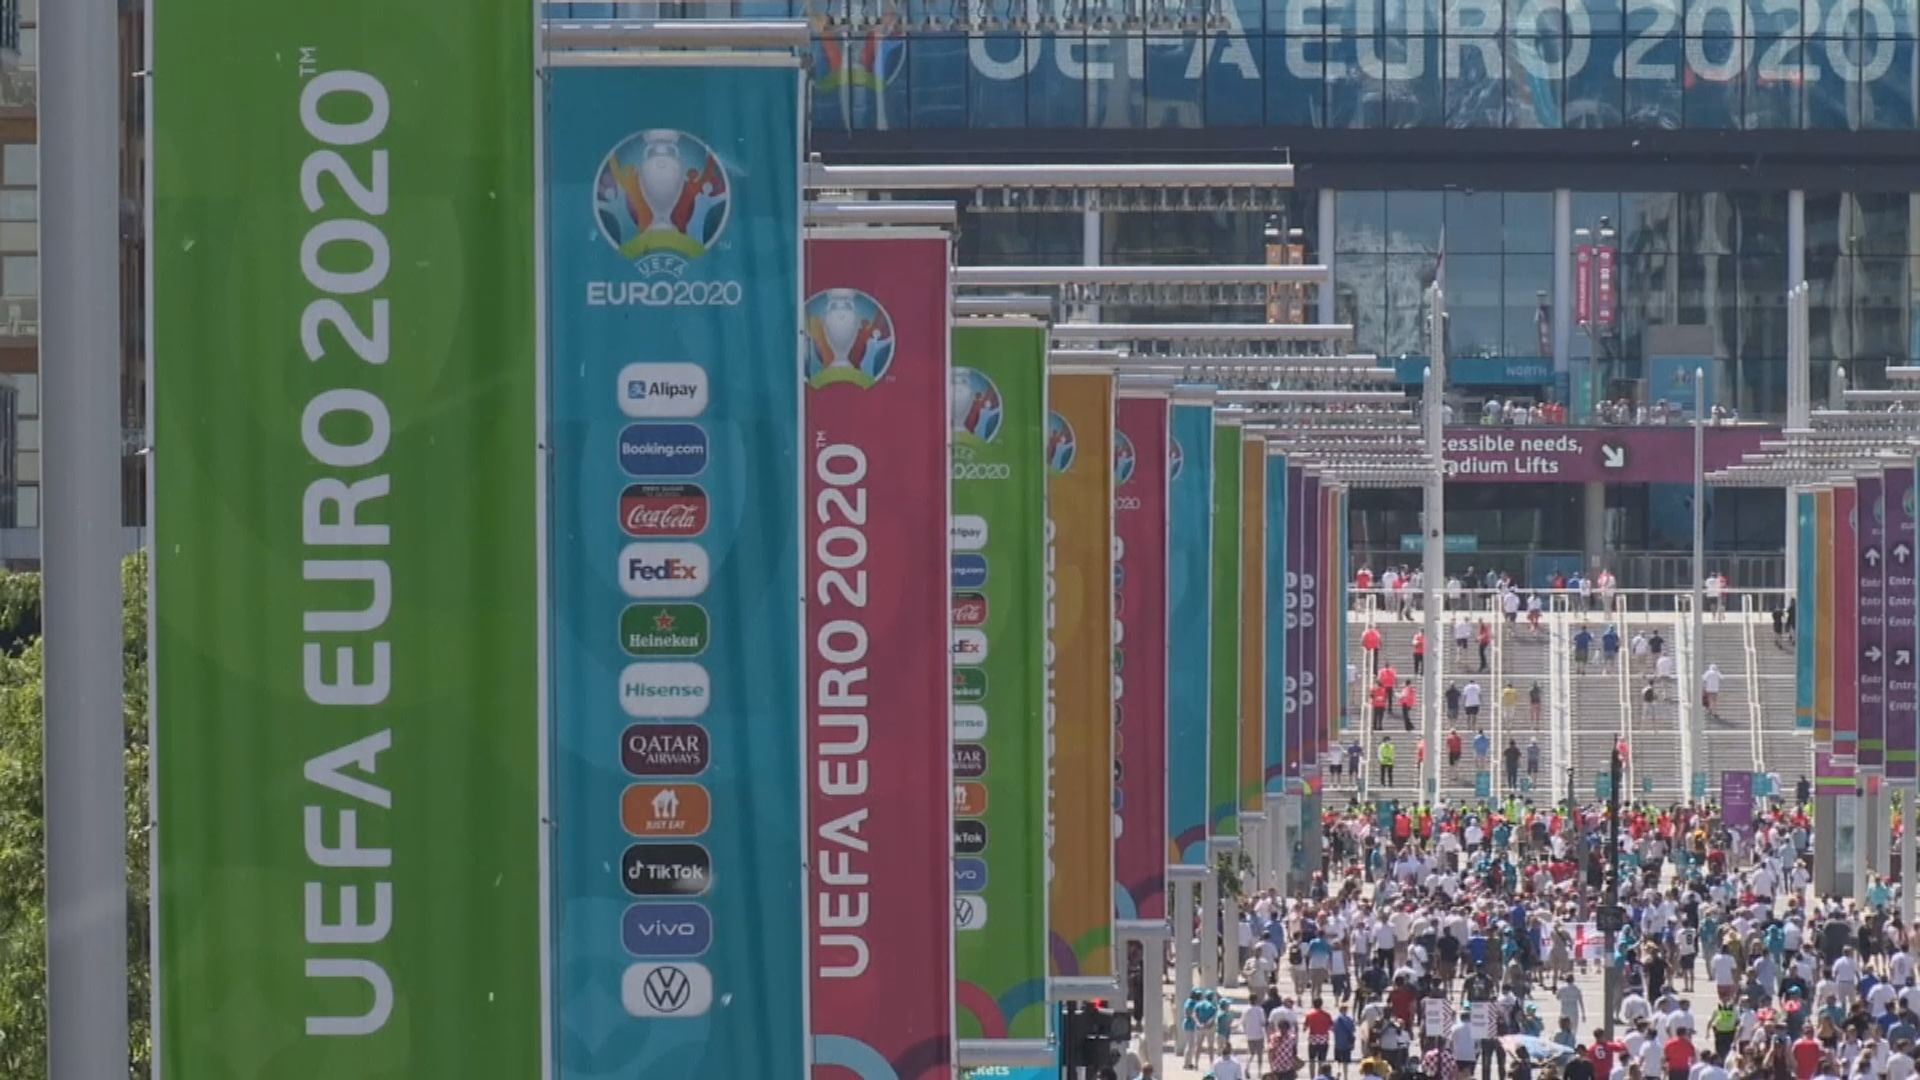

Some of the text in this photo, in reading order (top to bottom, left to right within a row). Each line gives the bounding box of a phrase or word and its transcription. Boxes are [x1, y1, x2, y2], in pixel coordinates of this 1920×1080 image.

[967, 0, 1897, 82] UEFA EURO 2020
[299, 69, 391, 364] 2020
[1506, 366, 1548, 377] NORTH
[649, 381, 697, 400] Alipay
[622, 442, 704, 458] Booking.com
[1521, 435, 1583, 455] needs,
[1514, 456, 1560, 474] Lifts
[816, 443, 868, 608] 2020
[301, 387, 392, 706] EURO
[629, 558, 697, 581] FedEx
[629, 633, 699, 647] Heineken
[625, 683, 704, 698] Hisense
[816, 619, 869, 796] EURO
[629, 735, 700, 755] QATAR
[646, 753, 701, 765] AIRWAYS
[646, 820, 686, 830] JUST EAT
[648, 864, 704, 880] TikTok
[304, 728, 394, 1036] UEFA
[818, 807, 870, 978] UEFA
[638, 920, 696, 937] vivo
